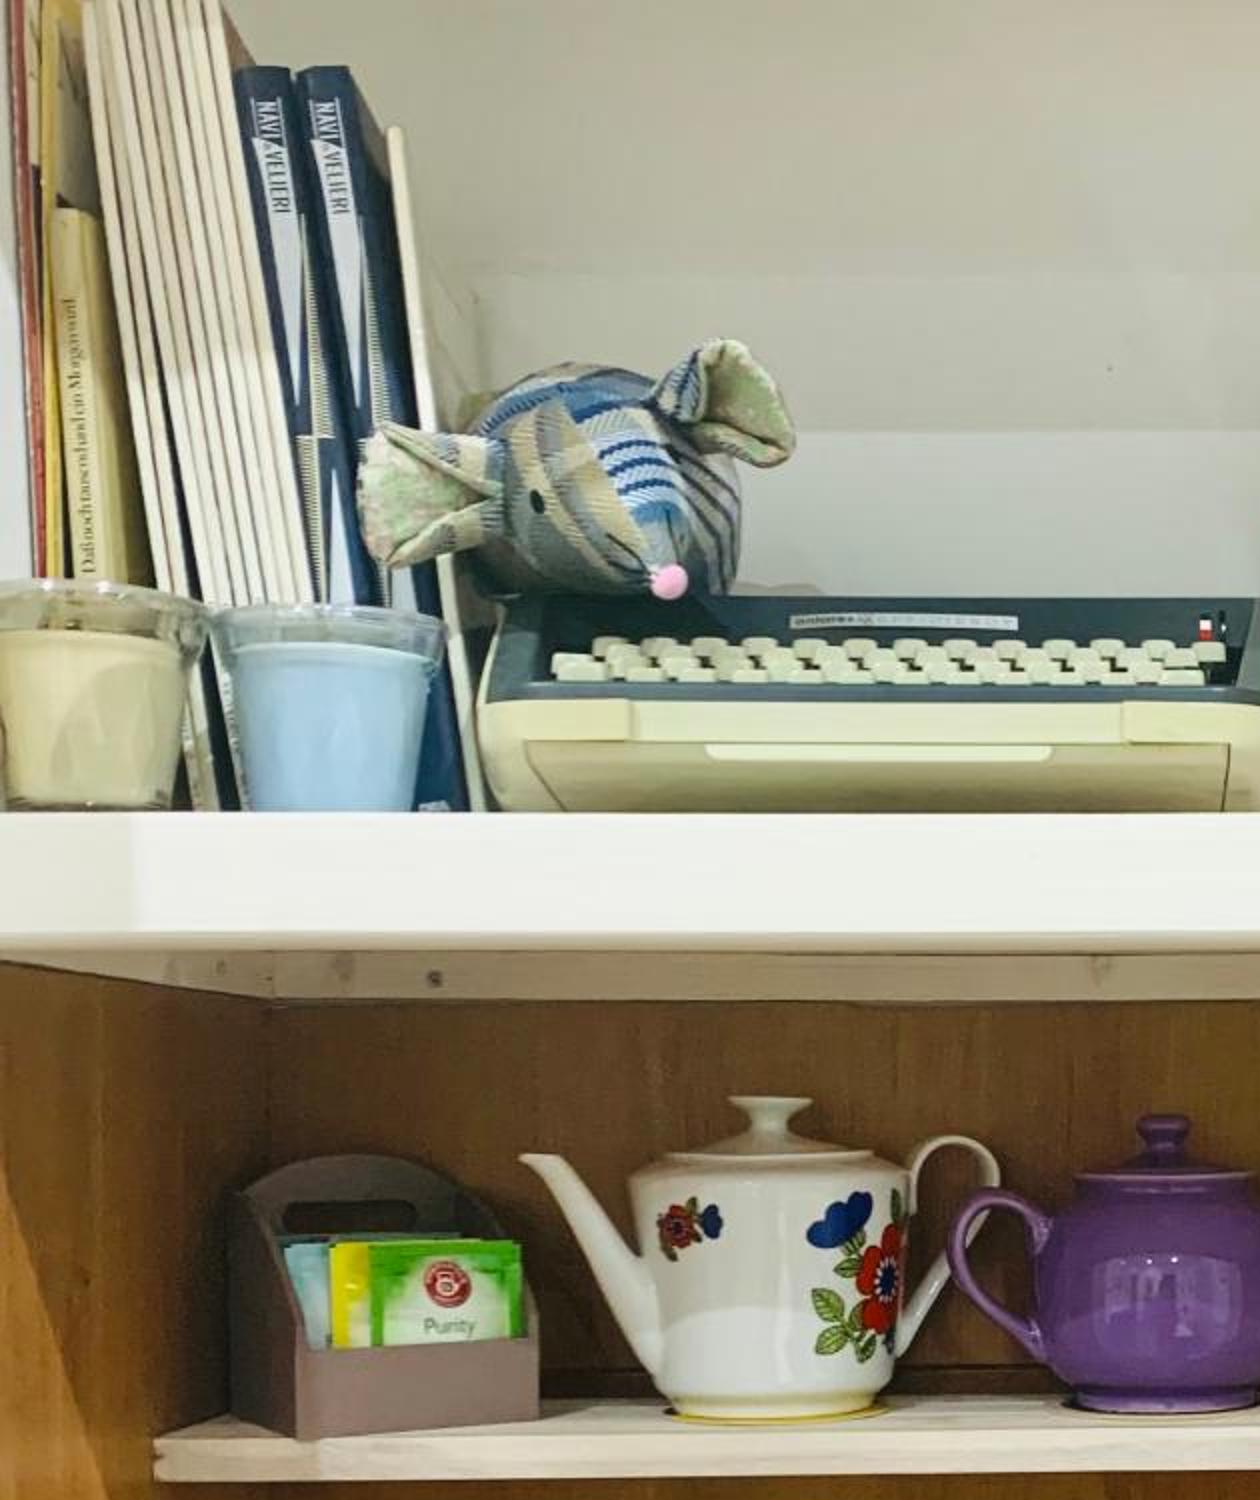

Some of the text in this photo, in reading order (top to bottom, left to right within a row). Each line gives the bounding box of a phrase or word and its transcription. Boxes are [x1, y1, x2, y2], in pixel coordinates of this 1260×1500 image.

[255, 100, 292, 214] NAVI VELIERI
[314, 101, 352, 215] NAVI VELIERI
[423, 1317, 477, 1338] Purity
